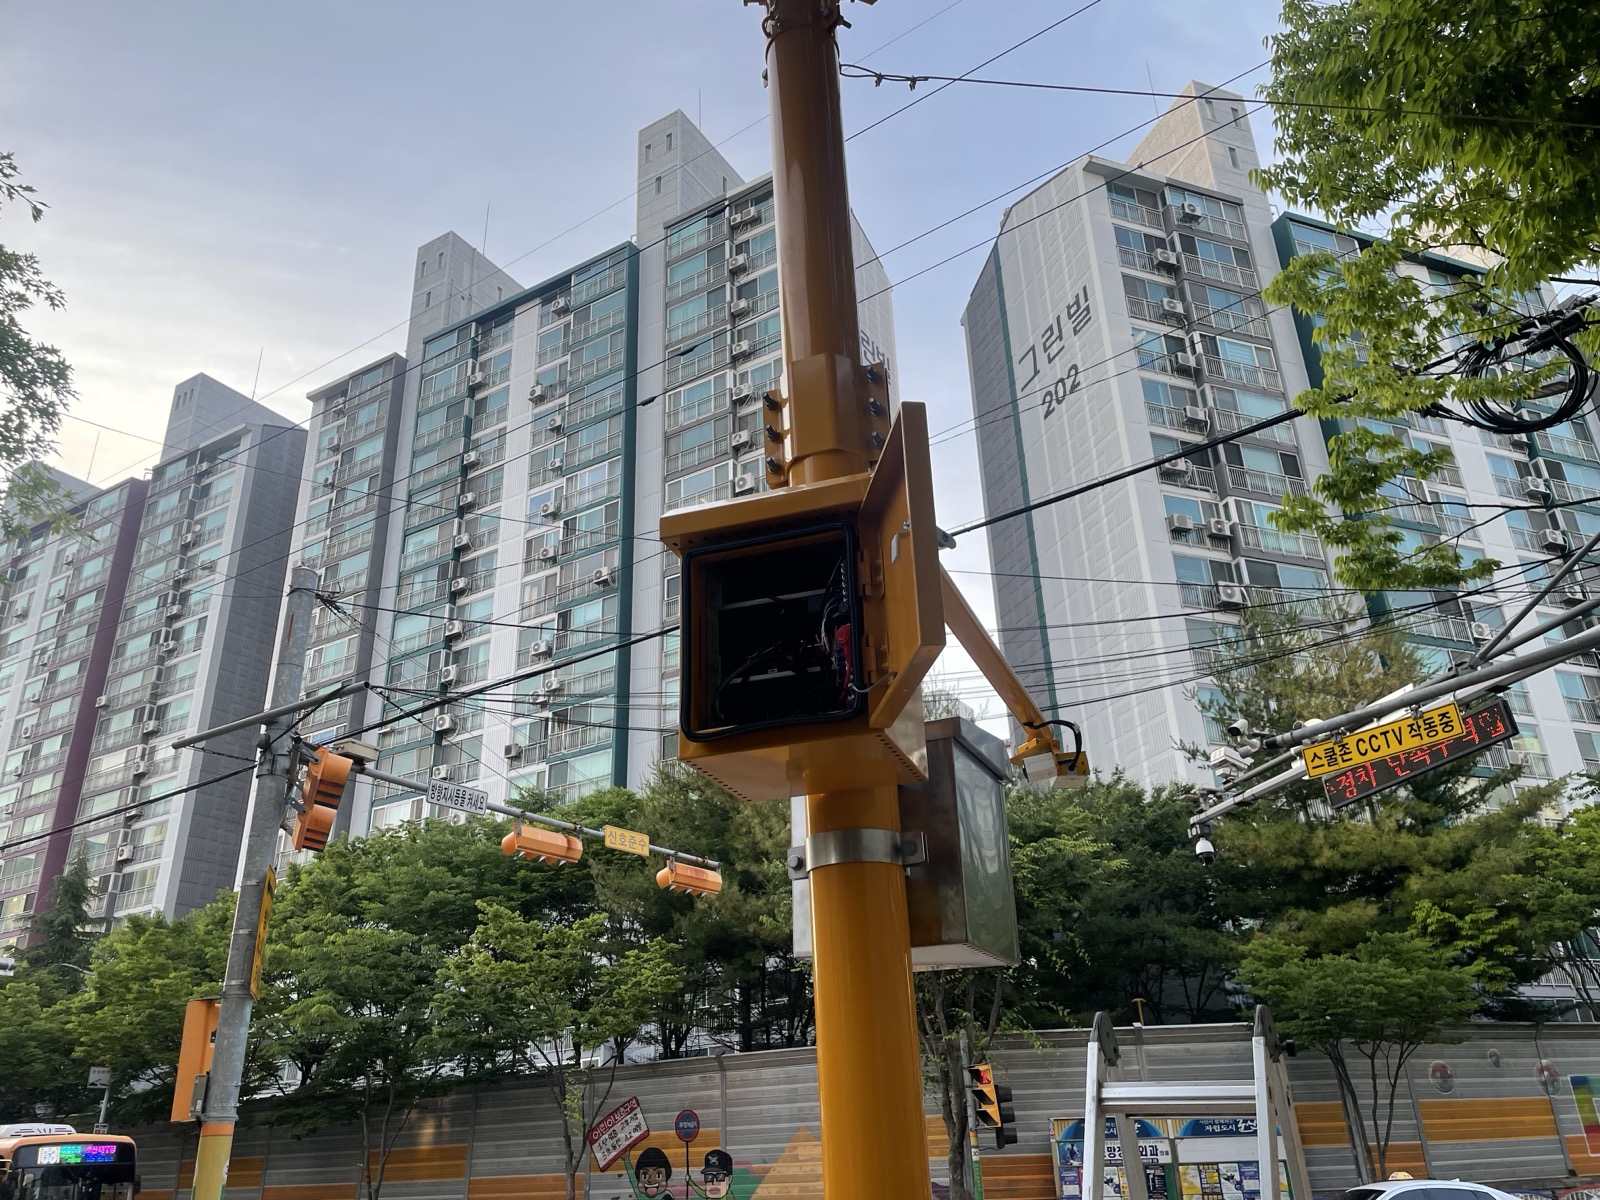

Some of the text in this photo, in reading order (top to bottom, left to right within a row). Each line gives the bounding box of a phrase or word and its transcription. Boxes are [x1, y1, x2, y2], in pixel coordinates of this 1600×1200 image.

[1018, 284, 1092, 393] 그린빌
[1042, 363, 1081, 420] 202
[1310, 711, 1456, 769] 스쿨존 CCTV 작동중
[430, 783, 485, 810] 방향지시등을 켜세요
[608, 830, 648, 852] 신호준수
